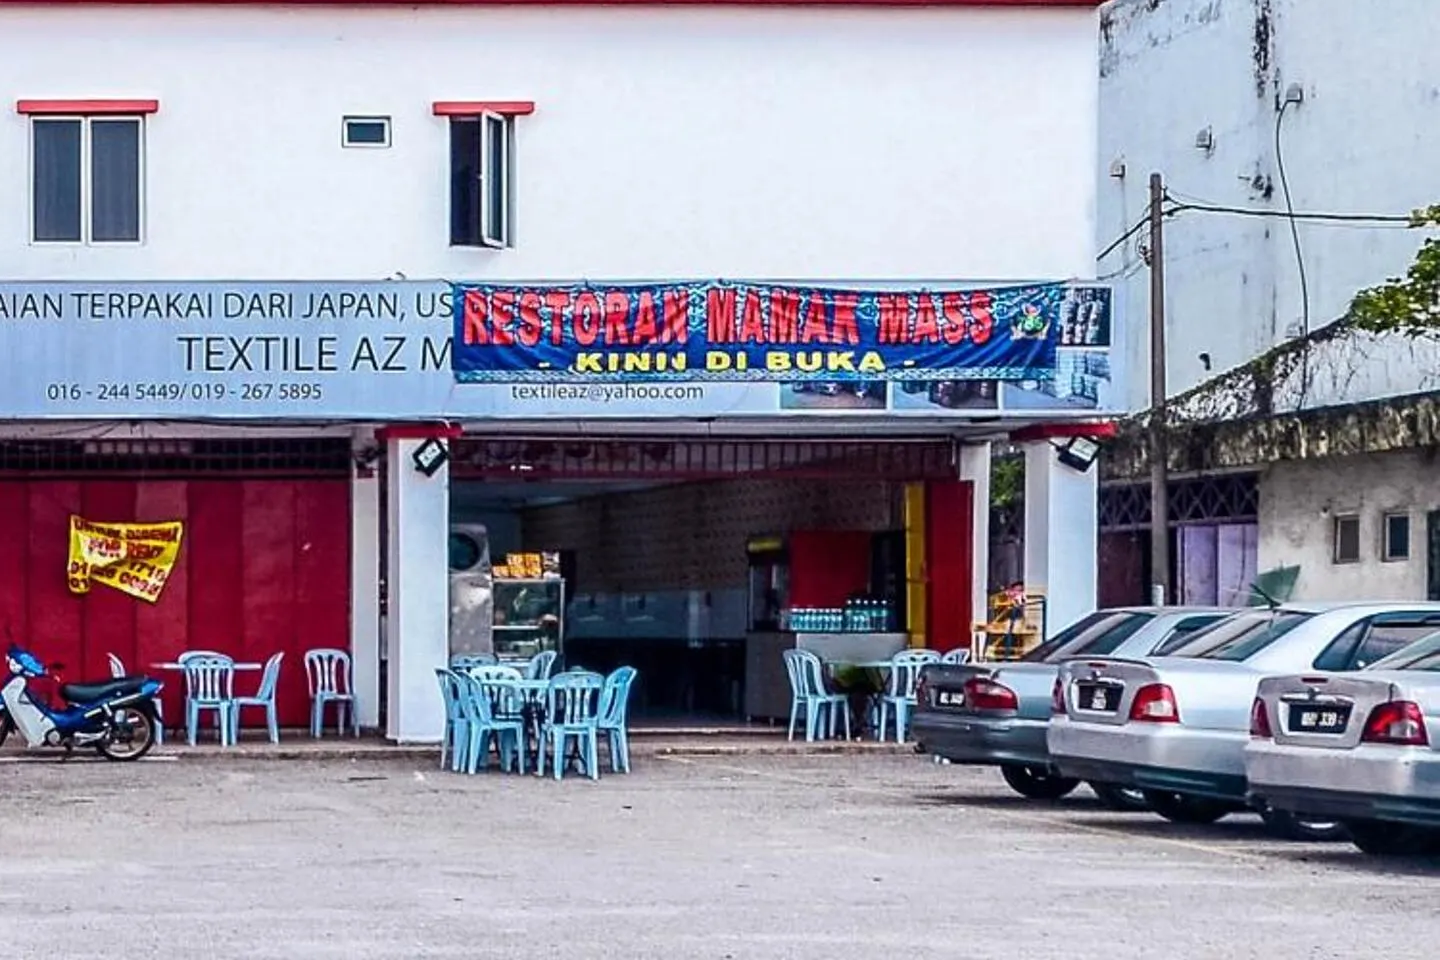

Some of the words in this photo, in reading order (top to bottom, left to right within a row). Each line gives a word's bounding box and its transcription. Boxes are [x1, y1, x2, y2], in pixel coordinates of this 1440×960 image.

[70, 293, 212, 319] TERPAKAI
[224, 292, 293, 318] DARI
[302, 292, 405, 321] JAPAN,
[464, 289, 689, 345] RESTORAN
[706, 289, 860, 344] MAMAK
[878, 291, 993, 345] MASS
[177, 337, 338, 371] TEXTILE
[351, 337, 407, 371] AZ
[706, 351, 747, 371] DI
[765, 351, 886, 371] BUKA
[47, 383, 81, 400] 016
[97, 383, 130, 400] 244
[191, 383, 225, 400] 019
[241, 383, 273, 400] 267
[279, 383, 322, 400] 5895
[512, 383, 704, 403] textileaz@yahoo.com
